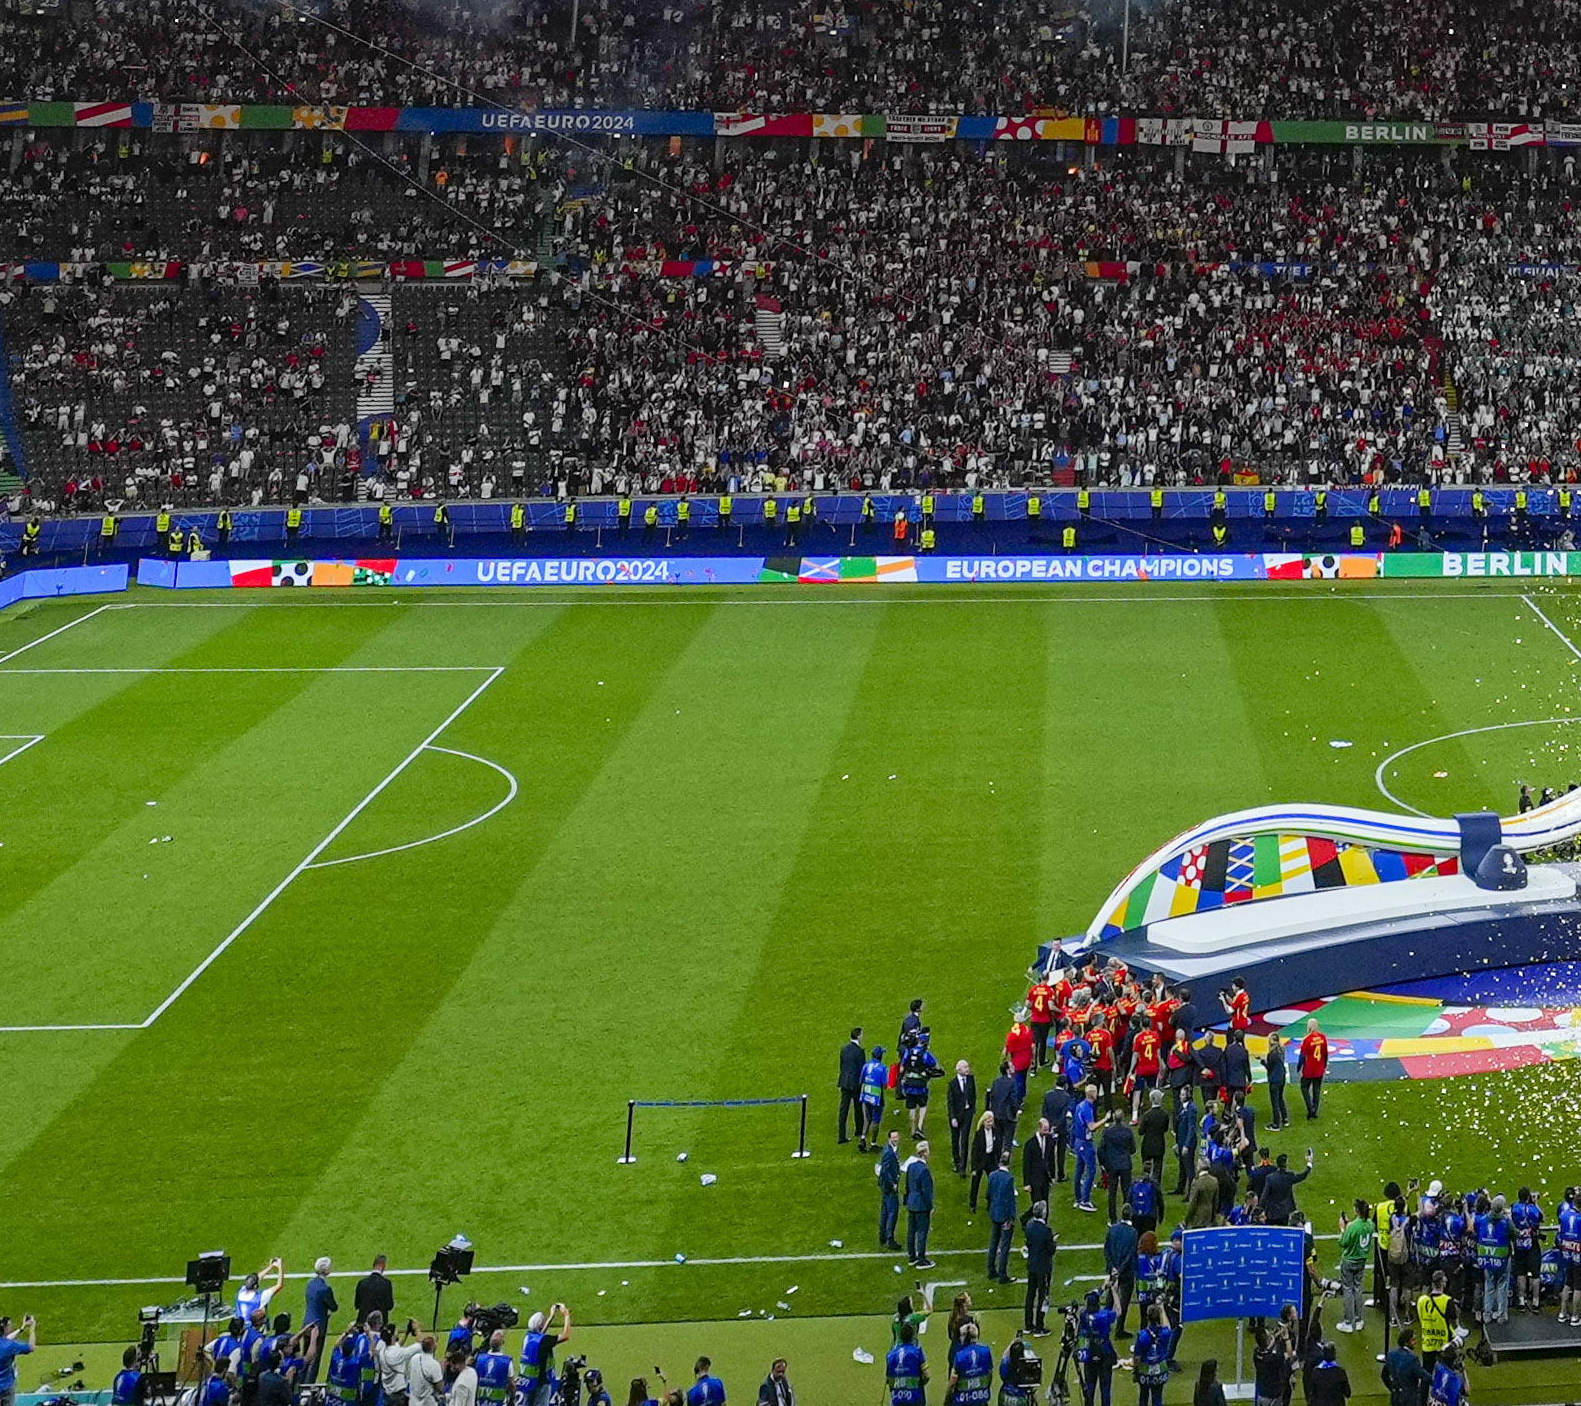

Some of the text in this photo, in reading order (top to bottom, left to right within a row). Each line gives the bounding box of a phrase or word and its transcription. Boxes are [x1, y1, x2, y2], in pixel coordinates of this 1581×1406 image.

[1345, 124, 1427, 141] BERLIN
[945, 558, 1234, 578] EUROPEAN CHAMPIONS
[1442, 552, 1567, 576] BERLIN
[1035, 995, 1044, 1012] 4
[1144, 1044, 1153, 1061] 4
[1314, 1044, 1321, 1062] 4
[1485, 1247, 1496, 1256] TV
